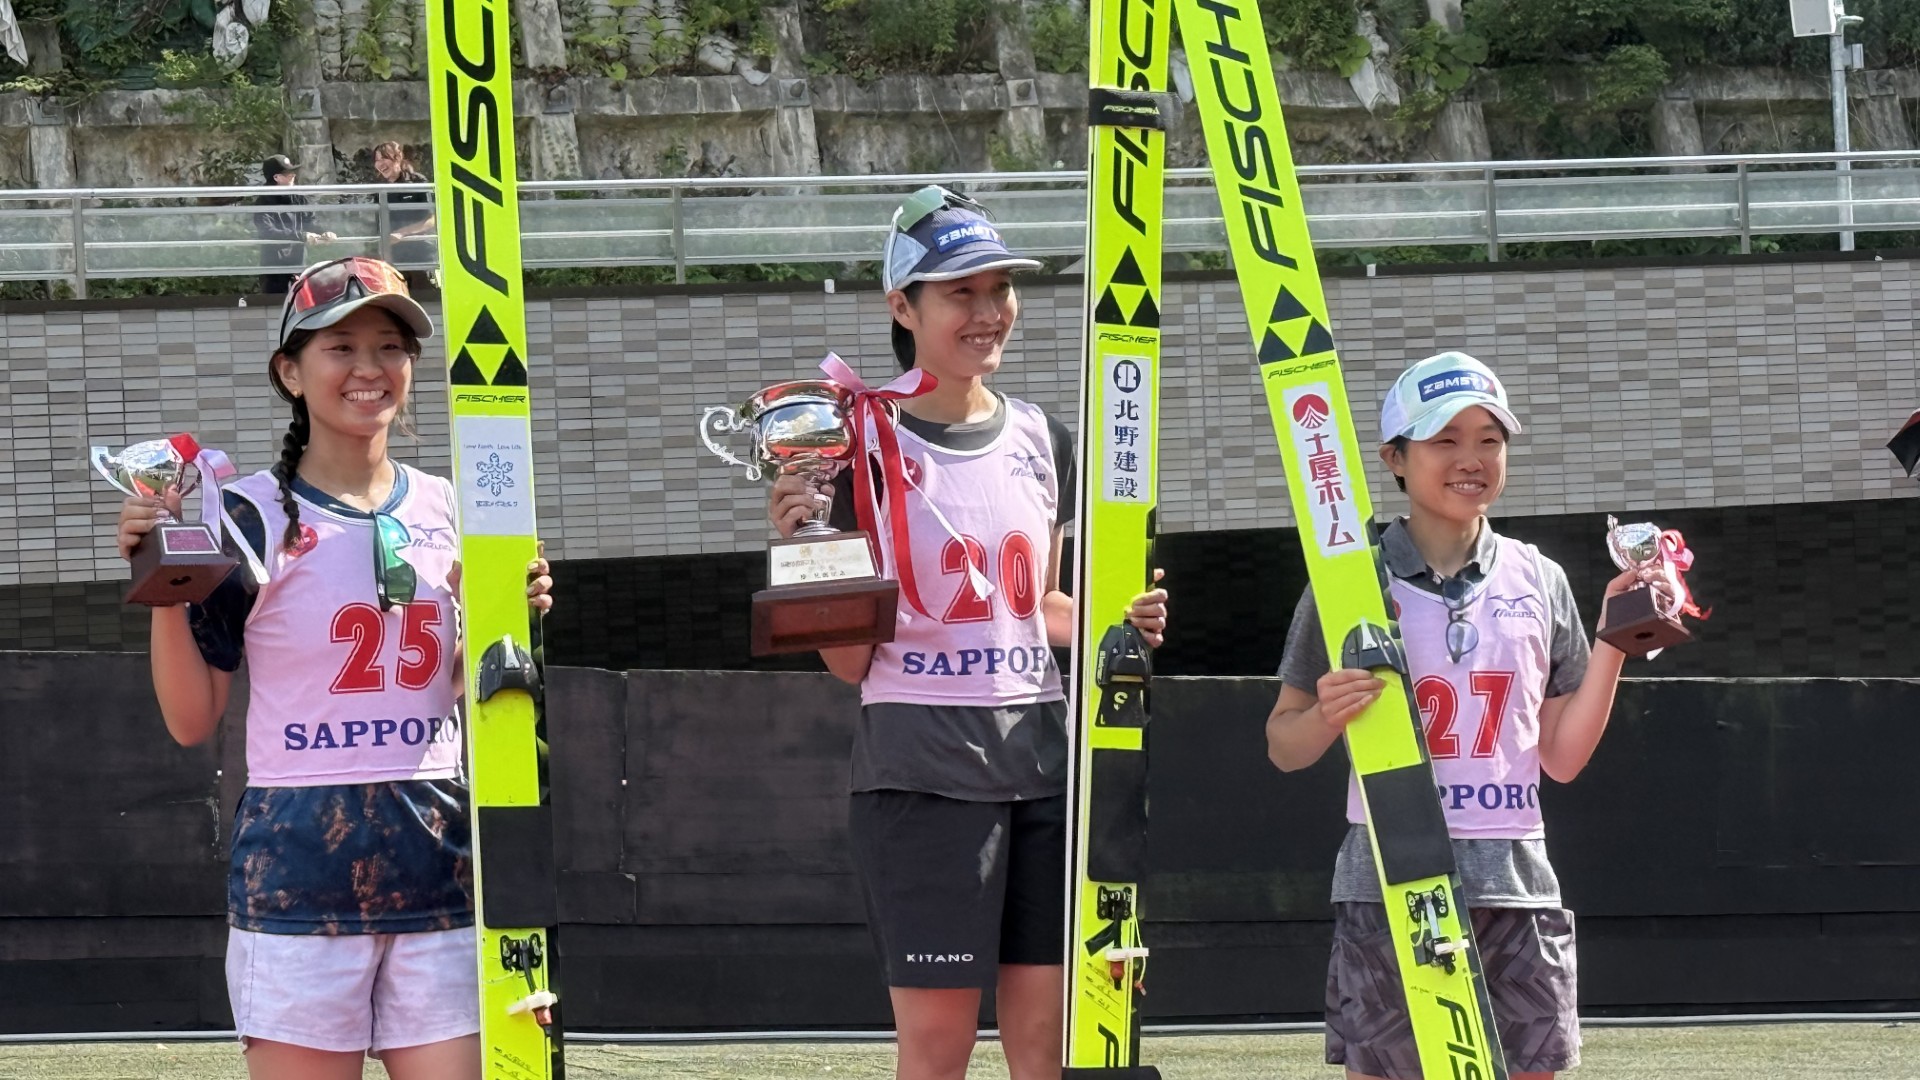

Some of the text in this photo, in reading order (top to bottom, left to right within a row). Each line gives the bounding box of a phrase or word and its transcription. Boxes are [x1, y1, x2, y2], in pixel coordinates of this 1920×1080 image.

[443, 0, 509, 297] FISC
[1196, 0, 1299, 271] FISCH
[1098, 332, 1157, 344] FISCHER
[1267, 359, 1336, 380] FISCHER
[455, 394, 526, 403] FISCHER
[1112, 399, 1140, 499] 北野建設
[1304, 432, 1356, 548] 土屋ホーム
[940, 530, 1037, 625] 20
[328, 600, 443, 695] 25
[284, 716, 459, 751] SAPPORO
[1413, 670, 1514, 760] 27
[906, 953, 974, 963] KITANO
